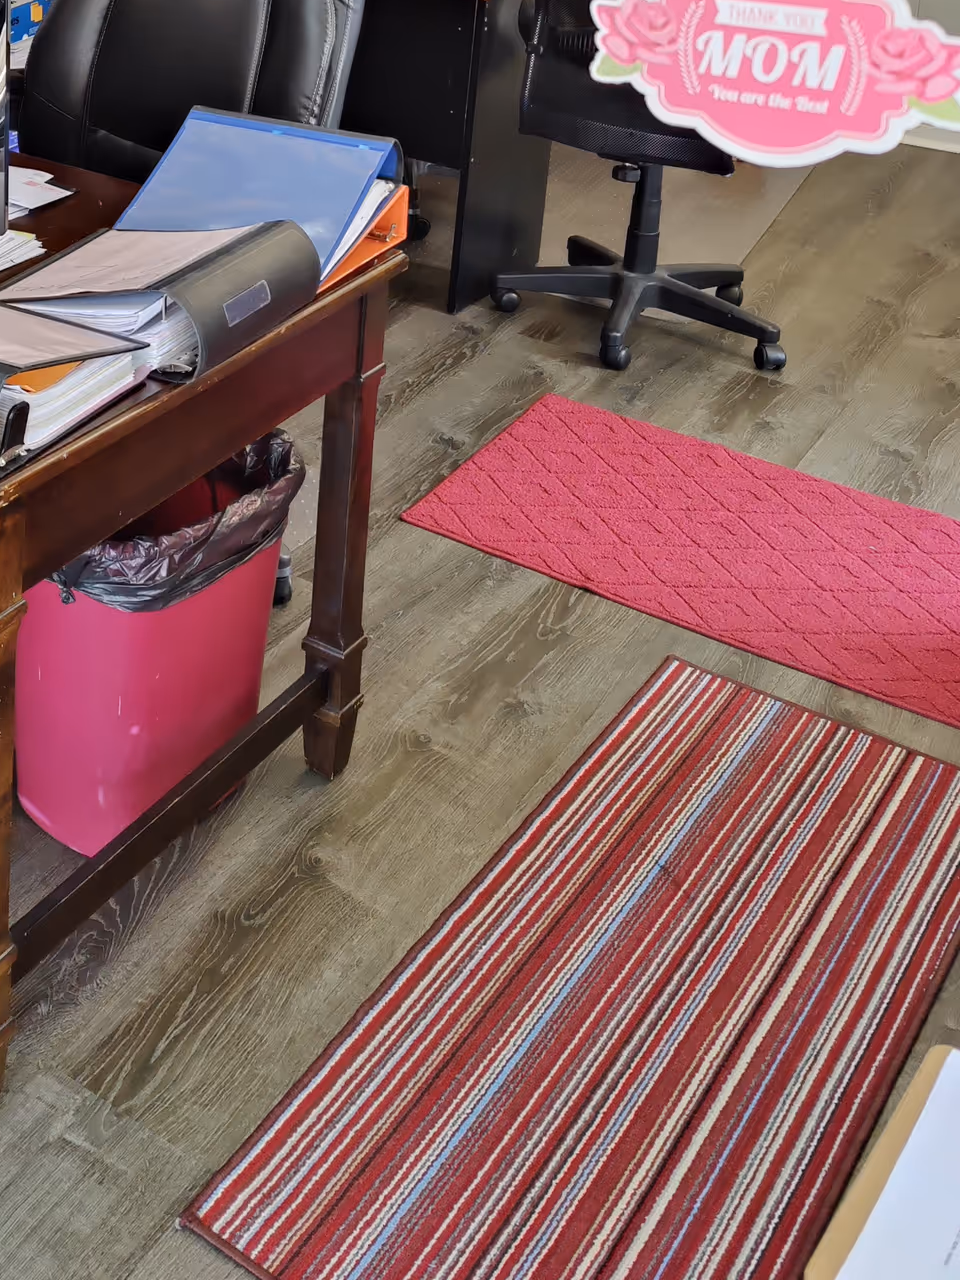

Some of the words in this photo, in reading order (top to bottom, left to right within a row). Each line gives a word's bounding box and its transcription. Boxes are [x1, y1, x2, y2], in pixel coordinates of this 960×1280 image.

[729, 3, 779, 25] THANK
[784, 13, 815, 31] YOU
[695, 29, 847, 92] MOM
[708, 83, 739, 103] You
[767, 92, 793, 110] the
